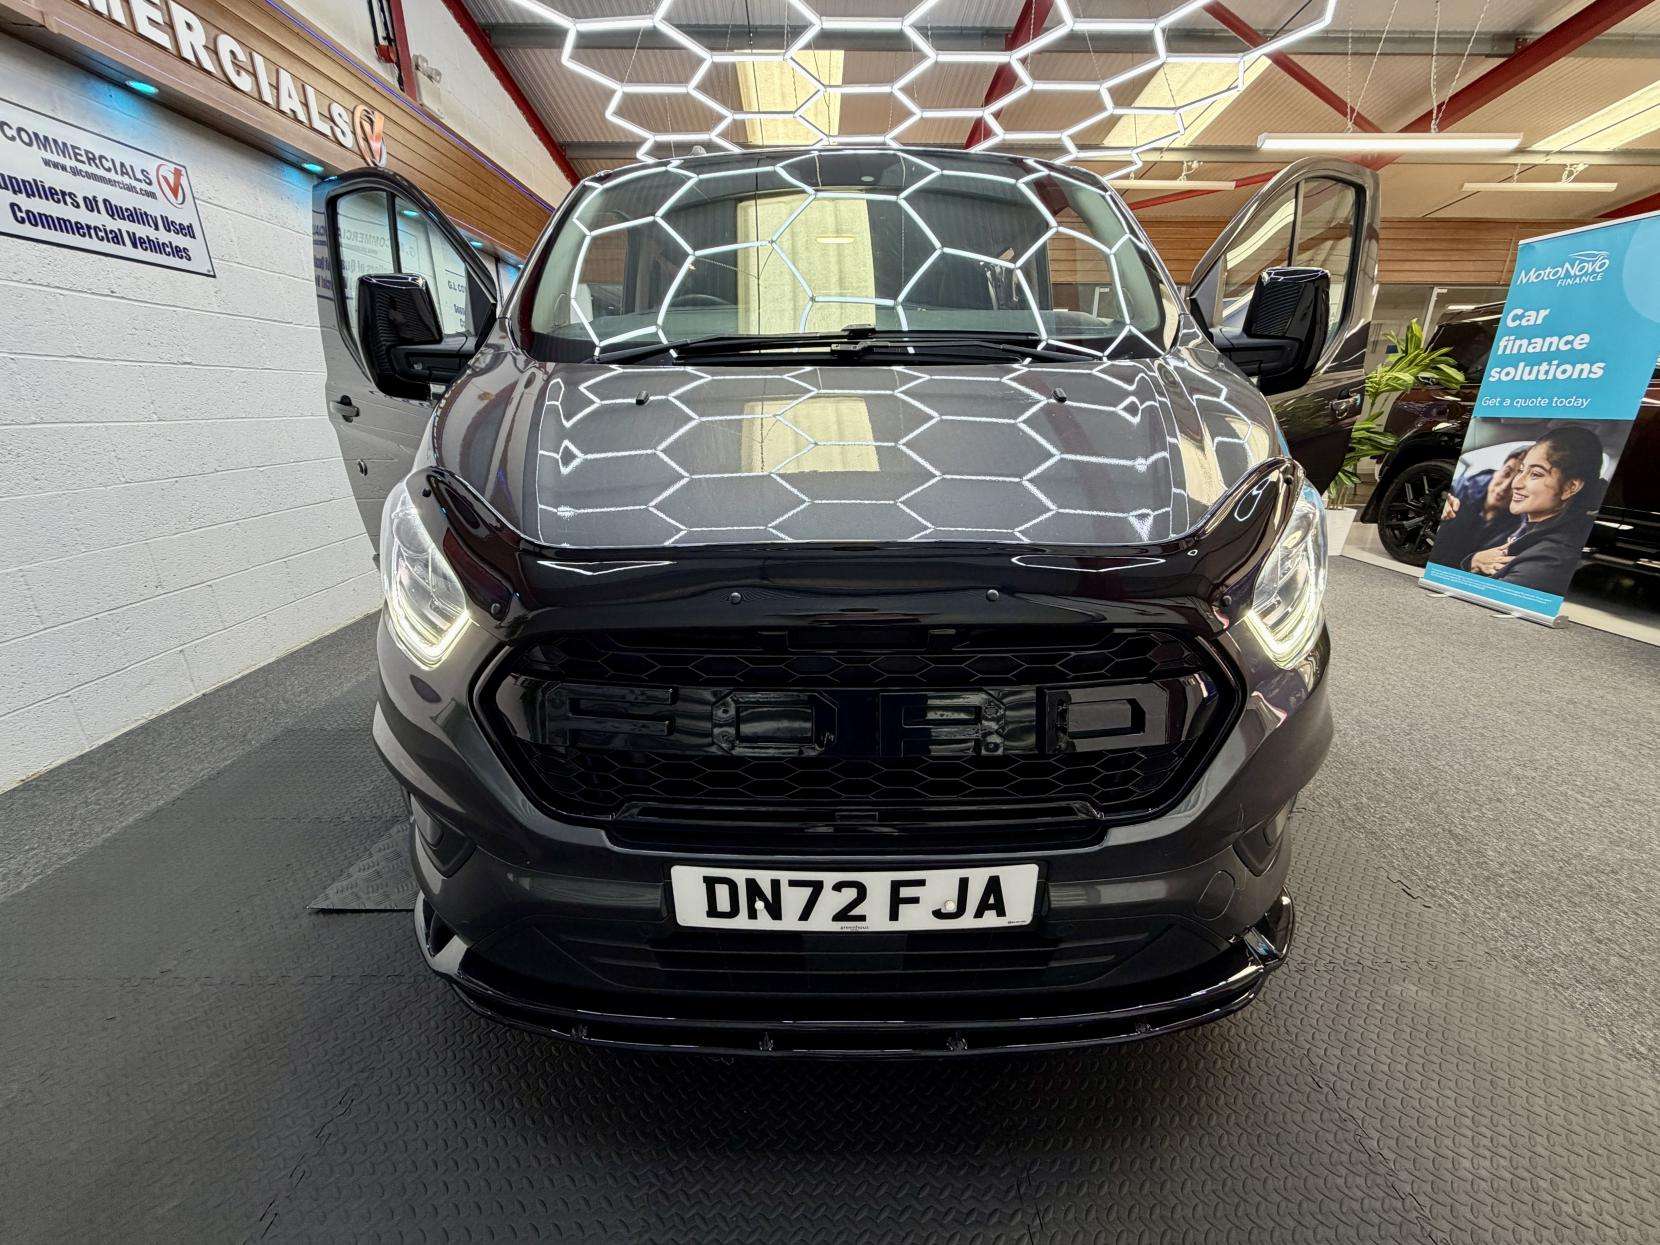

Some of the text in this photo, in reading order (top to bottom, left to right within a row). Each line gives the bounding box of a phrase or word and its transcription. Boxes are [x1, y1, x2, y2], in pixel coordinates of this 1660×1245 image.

[41, 156, 158, 200] www.glcommercials.com
[83, 194, 102, 214] of
[103, 197, 160, 231] Quality
[161, 214, 197, 239] Used
[9, 202, 192, 261] Commercial Vehicles
[1516, 254, 1610, 285] MotoNovo
[1556, 272, 1604, 287] FINANCE
[1506, 308, 1550, 328] Car
[1497, 333, 1591, 355] finance
[1488, 360, 1606, 382] solutions
[1481, 396, 1591, 409] Get a quote today
[702, 875, 1008, 922] DN72 FJA
